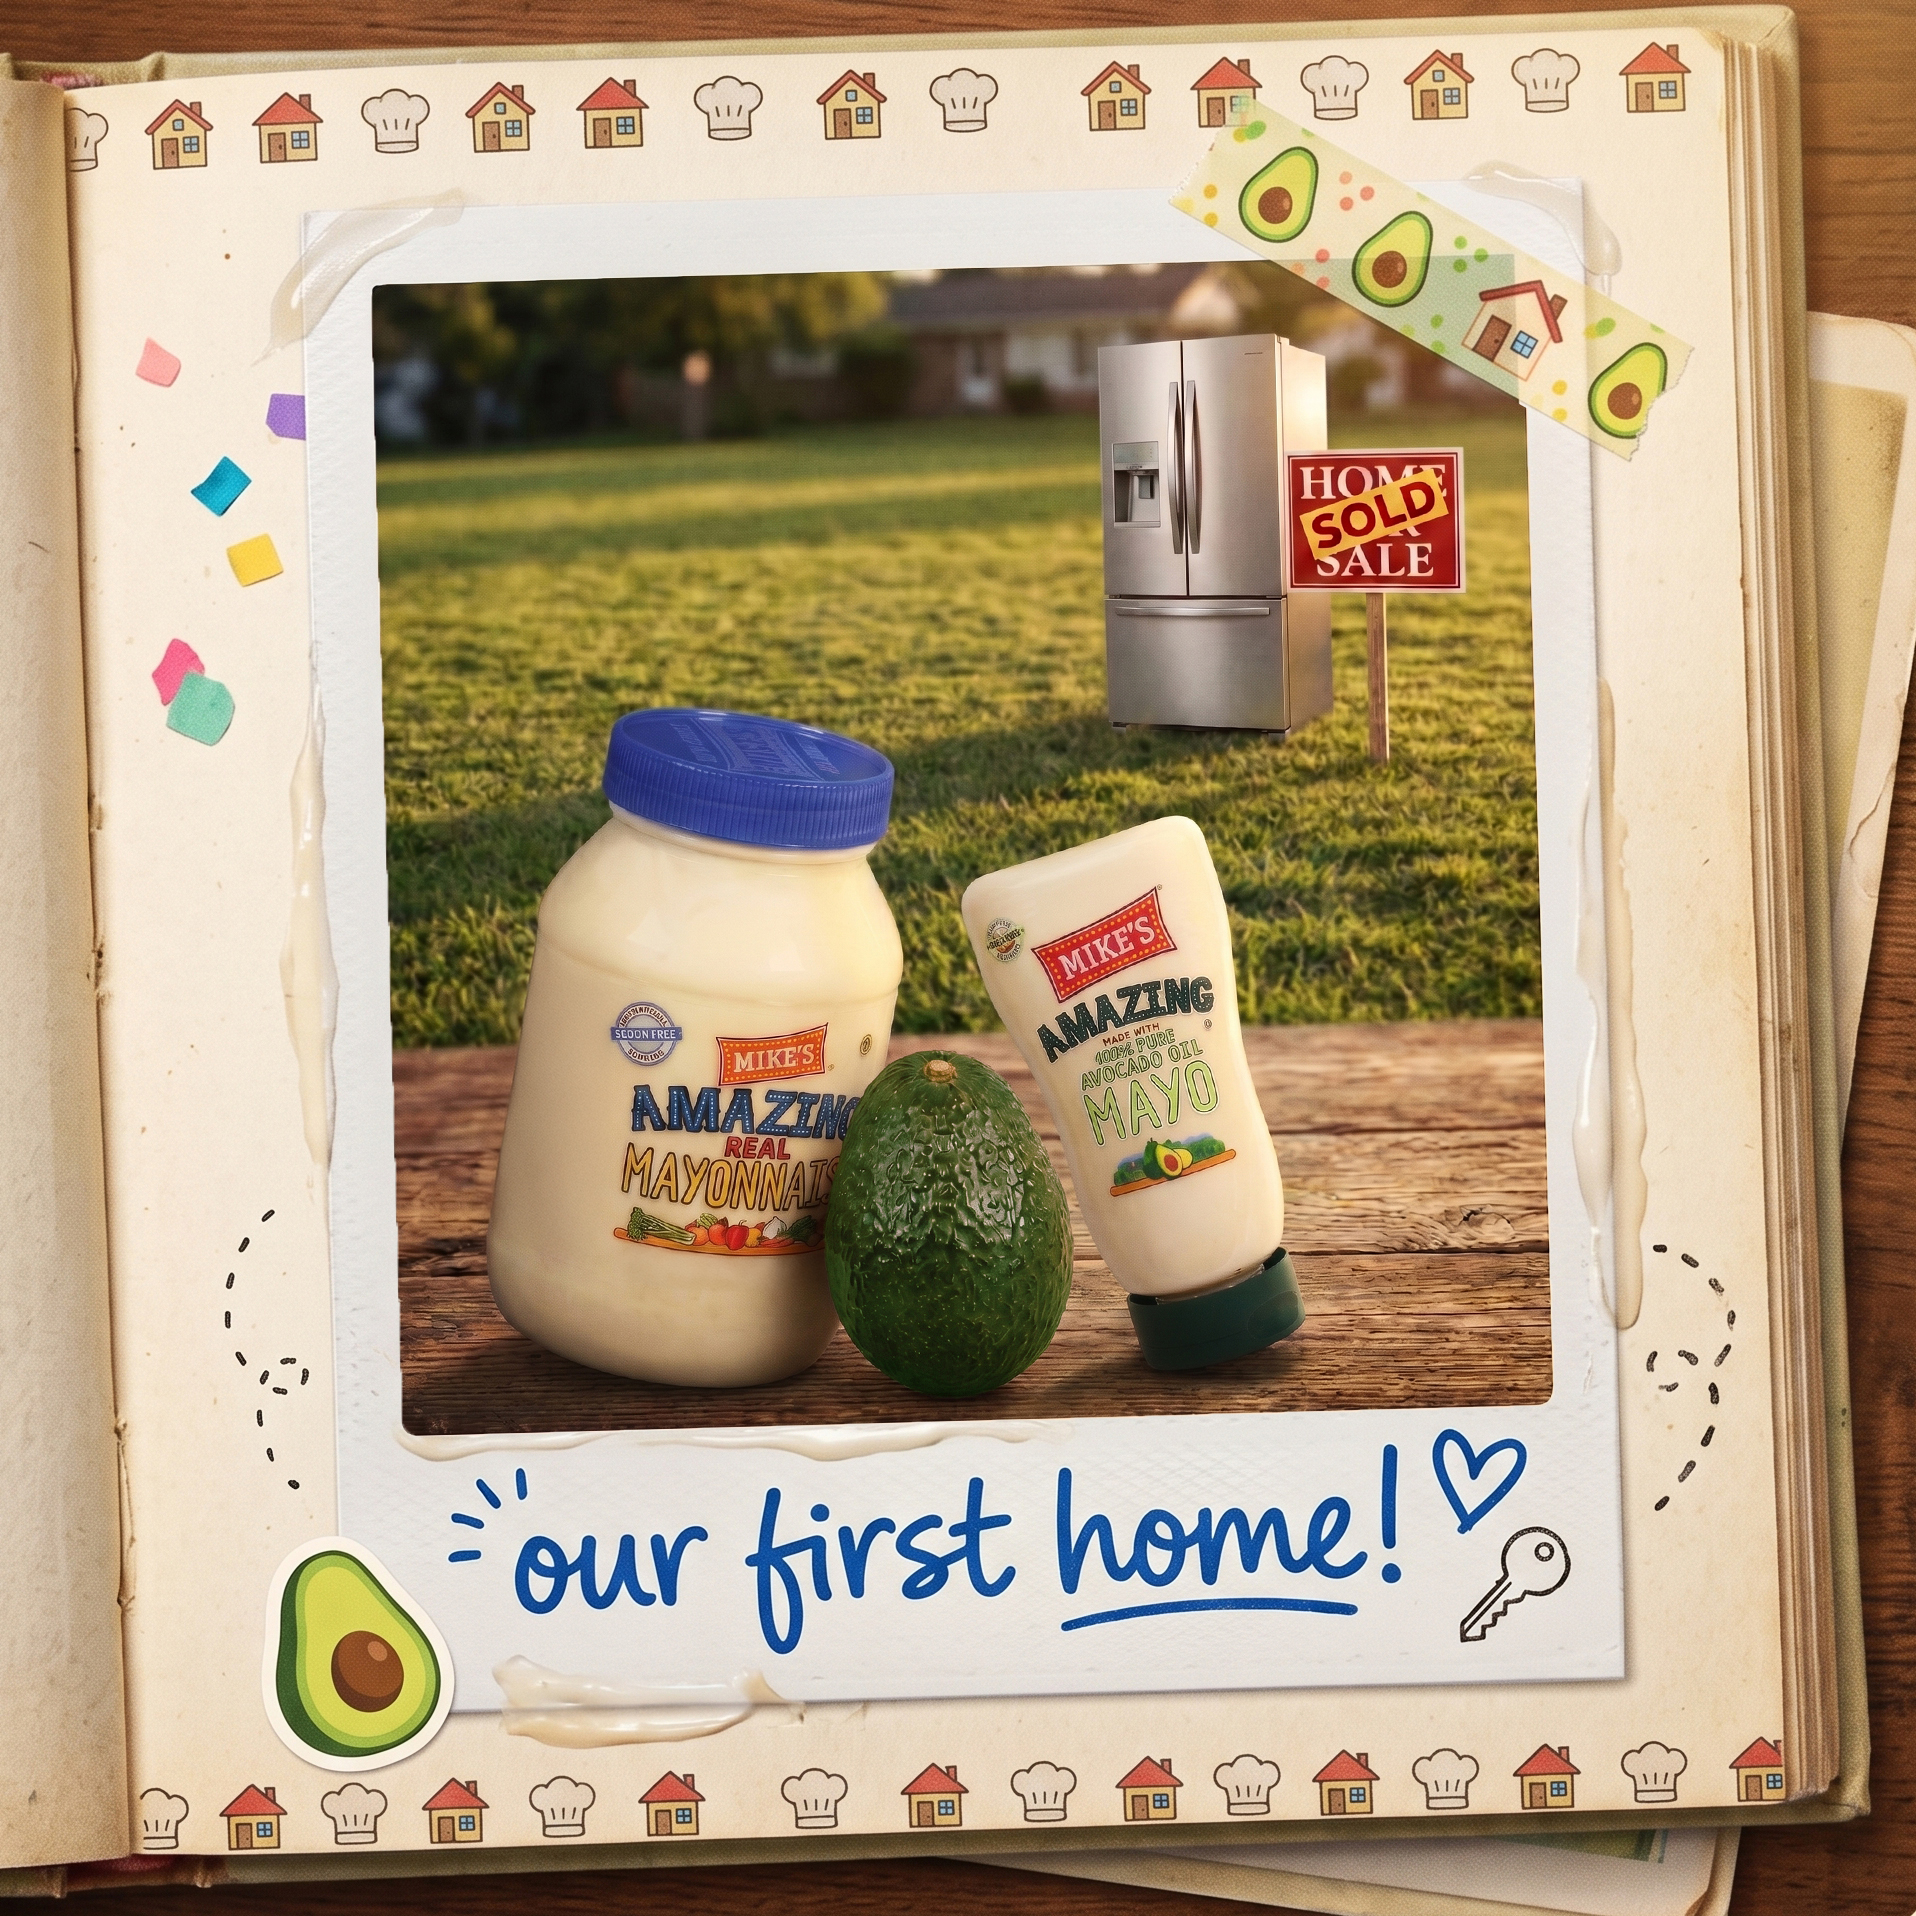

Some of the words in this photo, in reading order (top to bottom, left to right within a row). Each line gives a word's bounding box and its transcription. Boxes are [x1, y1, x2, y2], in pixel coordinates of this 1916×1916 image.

[1311, 481, 1436, 549] SOLD
[1316, 542, 1434, 577] SALE
[1057, 916, 1155, 981] MIKE'S
[651, 1029, 676, 1039] FREE
[1036, 975, 1215, 1064] AMAZING
[1102, 1031, 1131, 1047] MADE
[1133, 1022, 1160, 1037] WITH
[1135, 1028, 1176, 1053] PURE
[733, 1043, 815, 1073] MIKE'S
[1081, 1050, 1163, 1091] AVOCADO
[1167, 1038, 1204, 1063] OIL
[1083, 1059, 1219, 1145] MAYO
[724, 1136, 791, 1160] REAL
[514, 1522, 708, 1616] our
[745, 1477, 1016, 1655] first
[1058, 1444, 1403, 1595] home!
